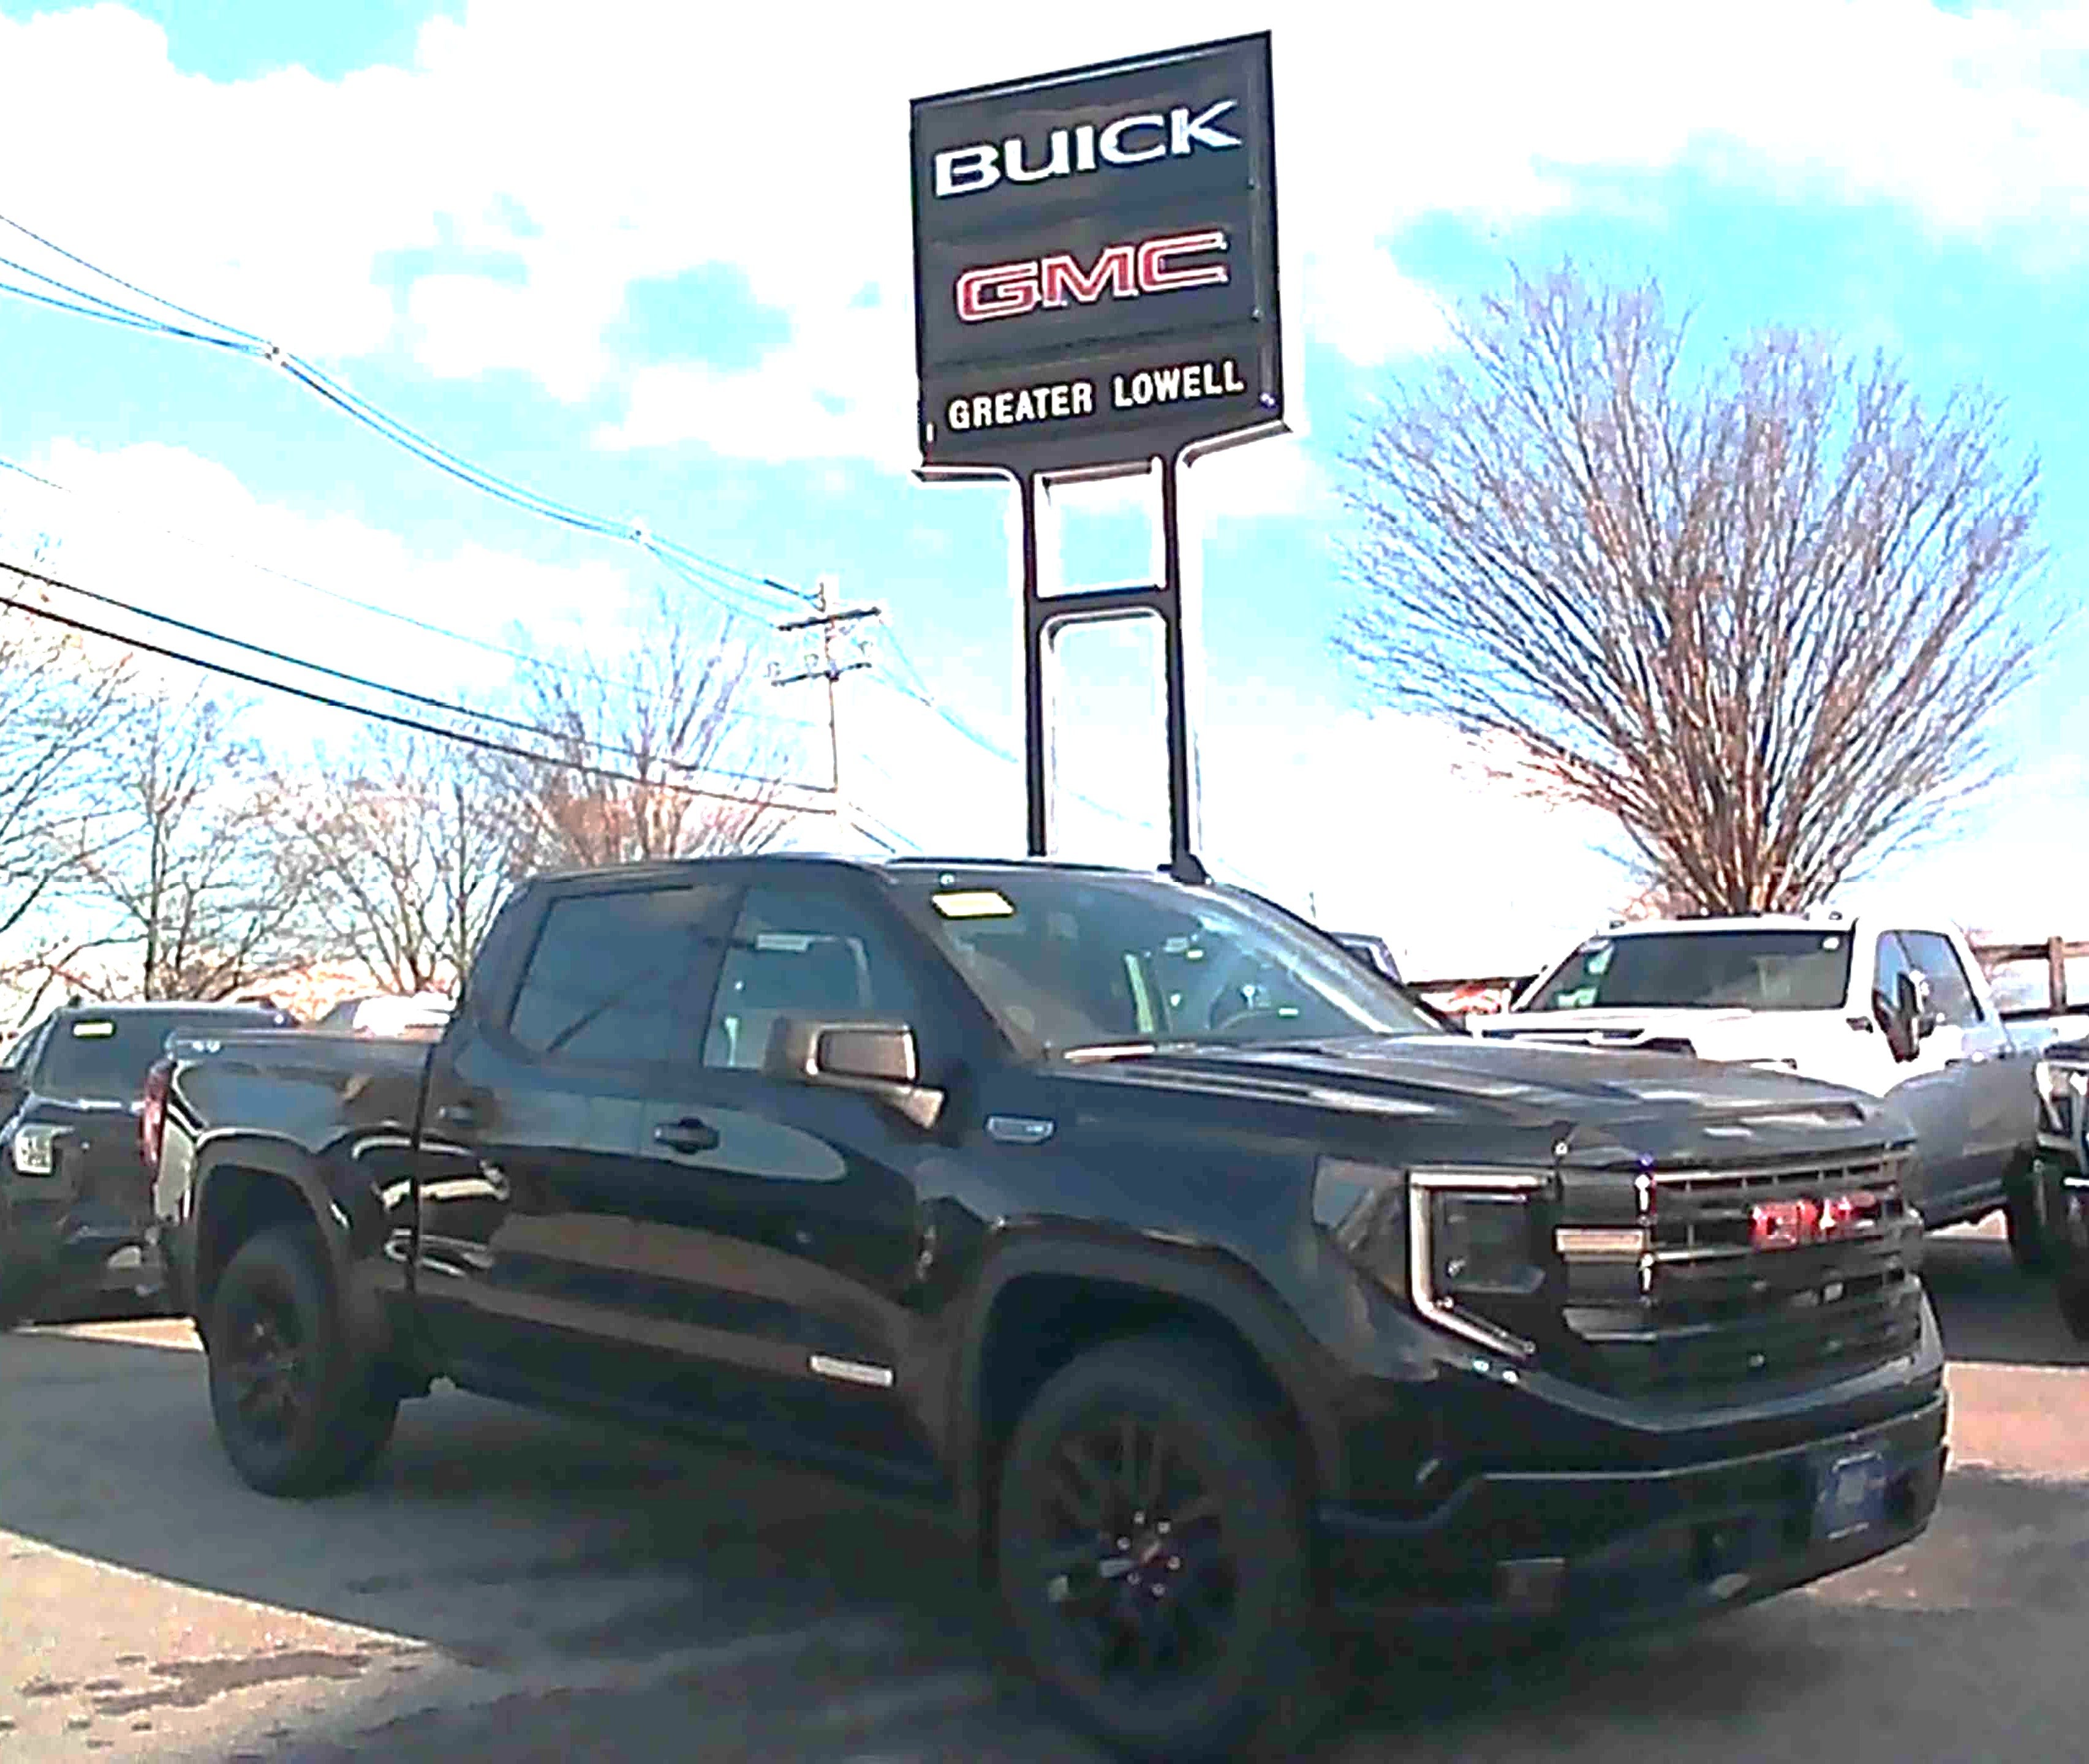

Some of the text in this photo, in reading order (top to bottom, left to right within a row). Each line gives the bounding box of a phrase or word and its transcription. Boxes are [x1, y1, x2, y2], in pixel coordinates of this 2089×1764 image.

[934, 98, 1242, 197] BUICK
[956, 230, 1228, 322] GMC
[948, 360, 1245, 429] GREATER LOWELL
